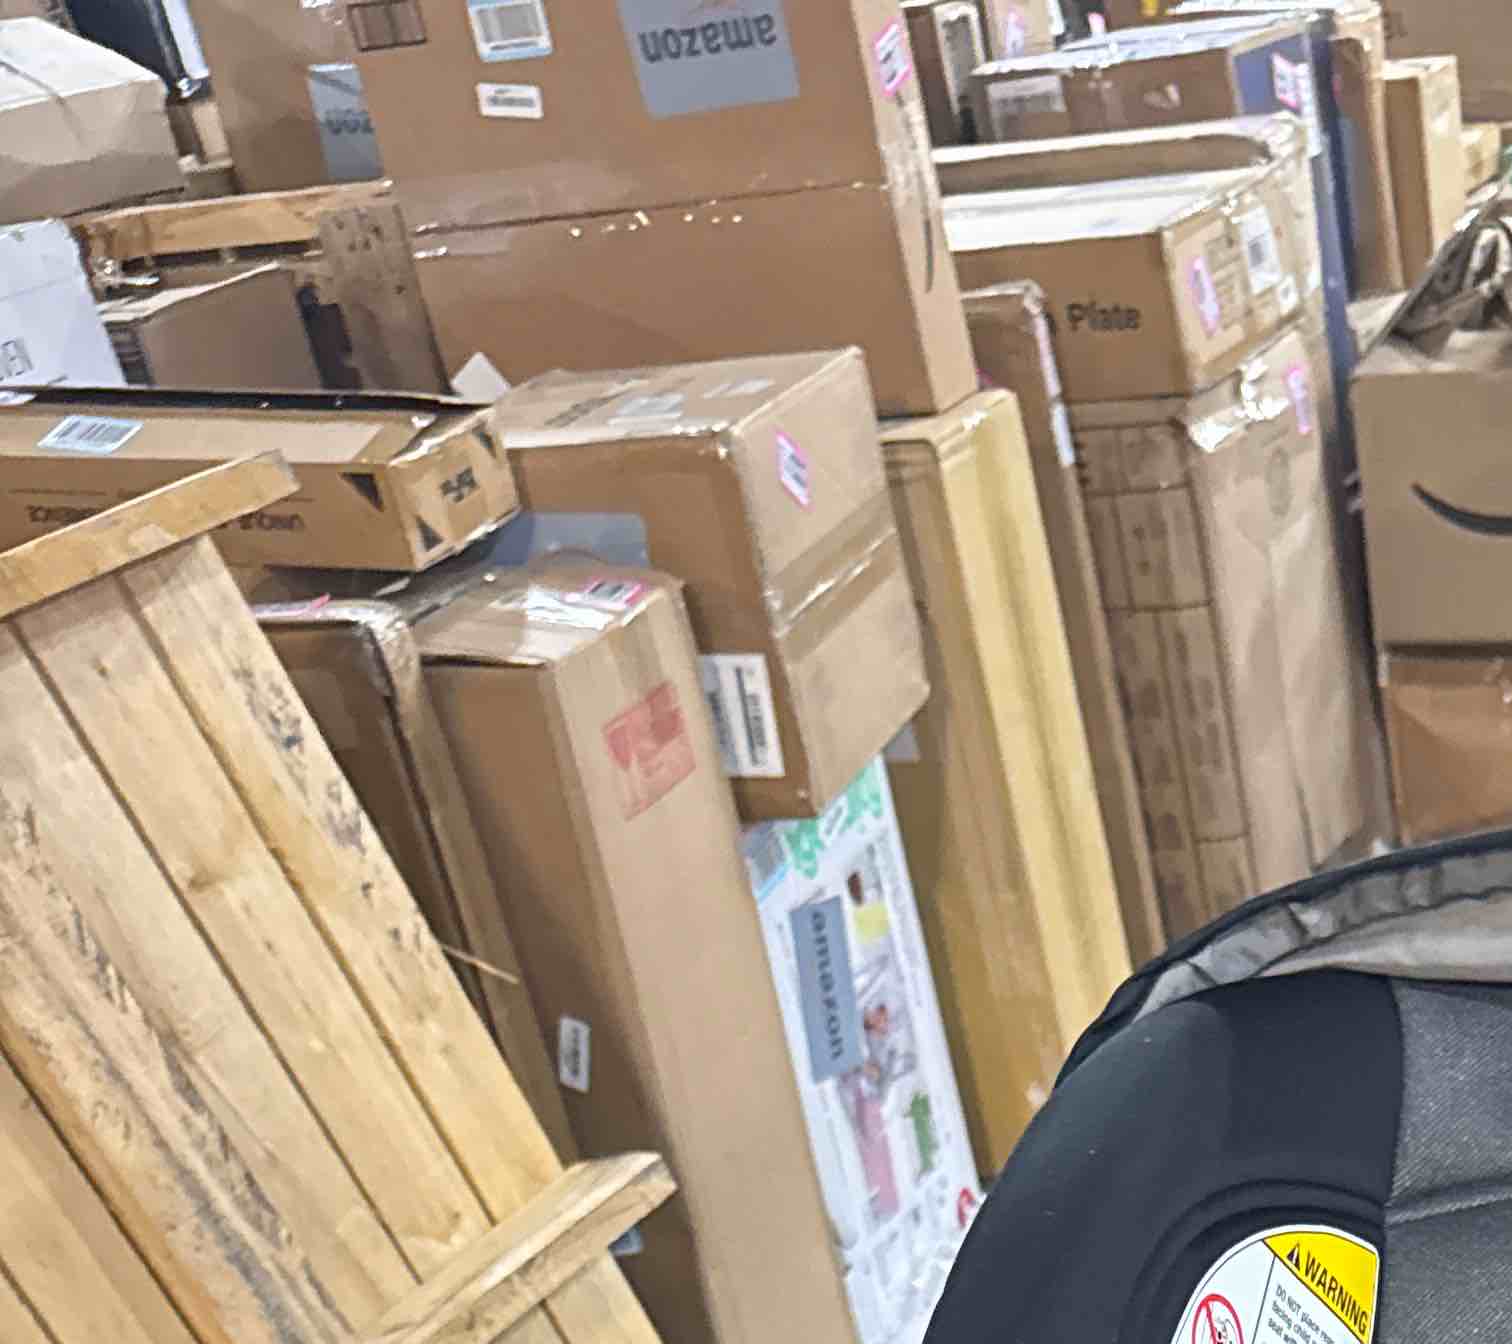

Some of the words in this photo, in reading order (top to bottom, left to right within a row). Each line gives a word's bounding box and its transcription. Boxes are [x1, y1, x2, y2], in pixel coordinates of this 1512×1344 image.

[638, 11, 777, 65] amazon
[1276, 1284, 1286, 1302] DO
[1288, 1295, 1301, 1316] NOT
[1301, 1311, 1320, 1335] place
[1305, 1250, 1368, 1336] WARNING
[1293, 1324, 1311, 1344] child
